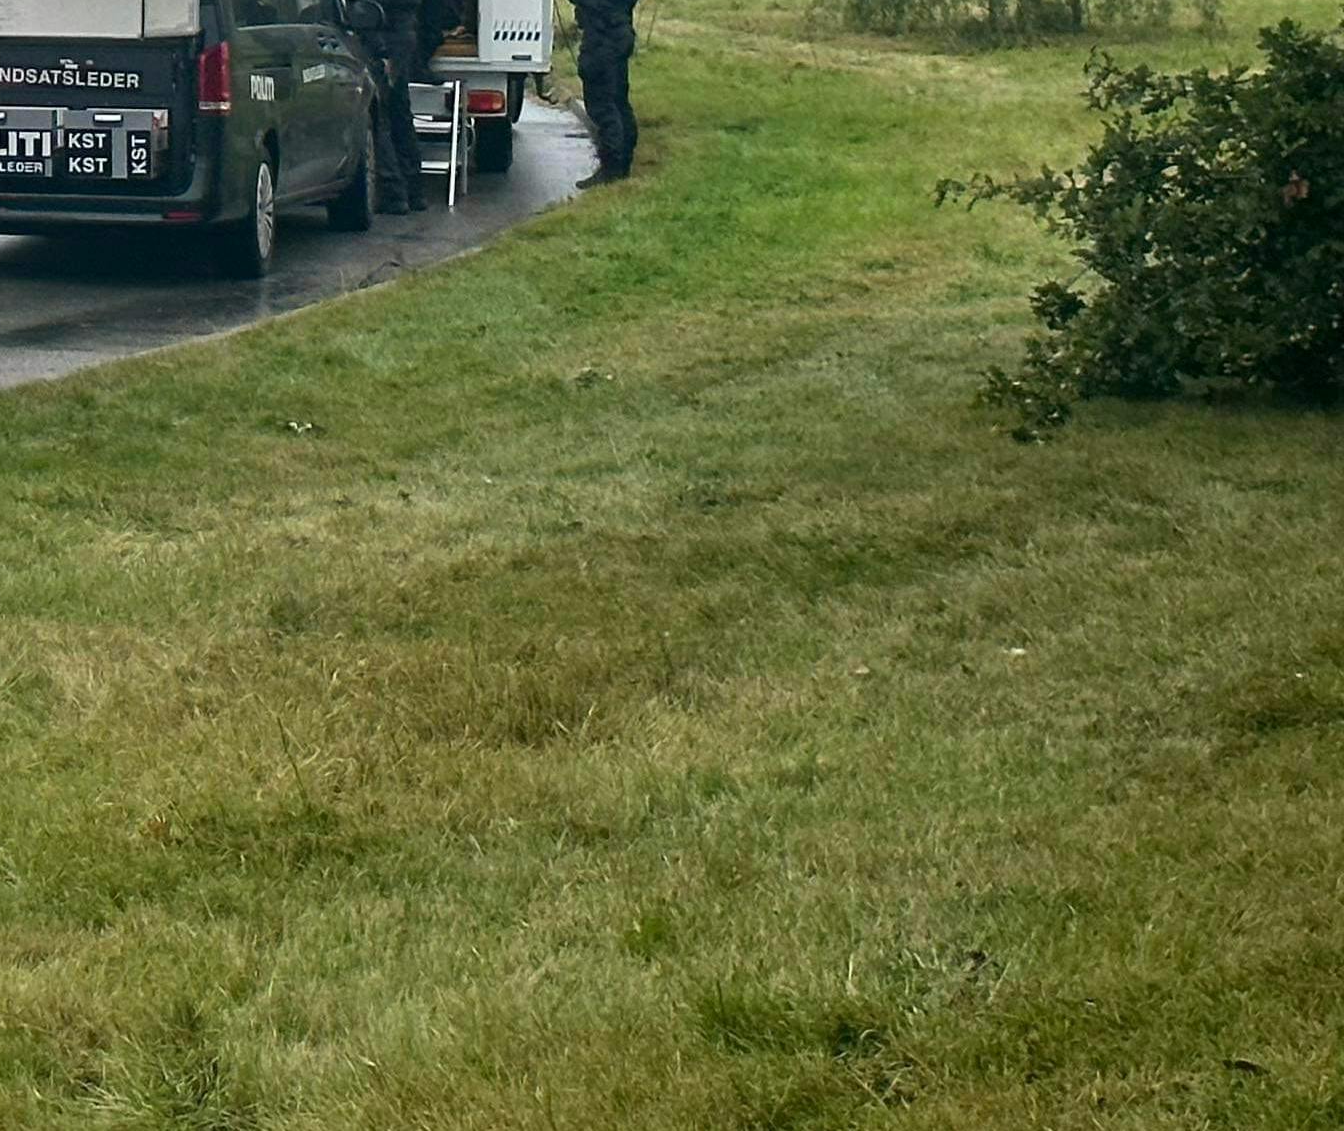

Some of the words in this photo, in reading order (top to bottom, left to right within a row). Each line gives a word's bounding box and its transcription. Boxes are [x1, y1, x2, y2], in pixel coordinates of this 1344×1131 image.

[67, 132, 107, 149] KST
[131, 134, 148, 175] KST
[69, 157, 109, 174] KST
